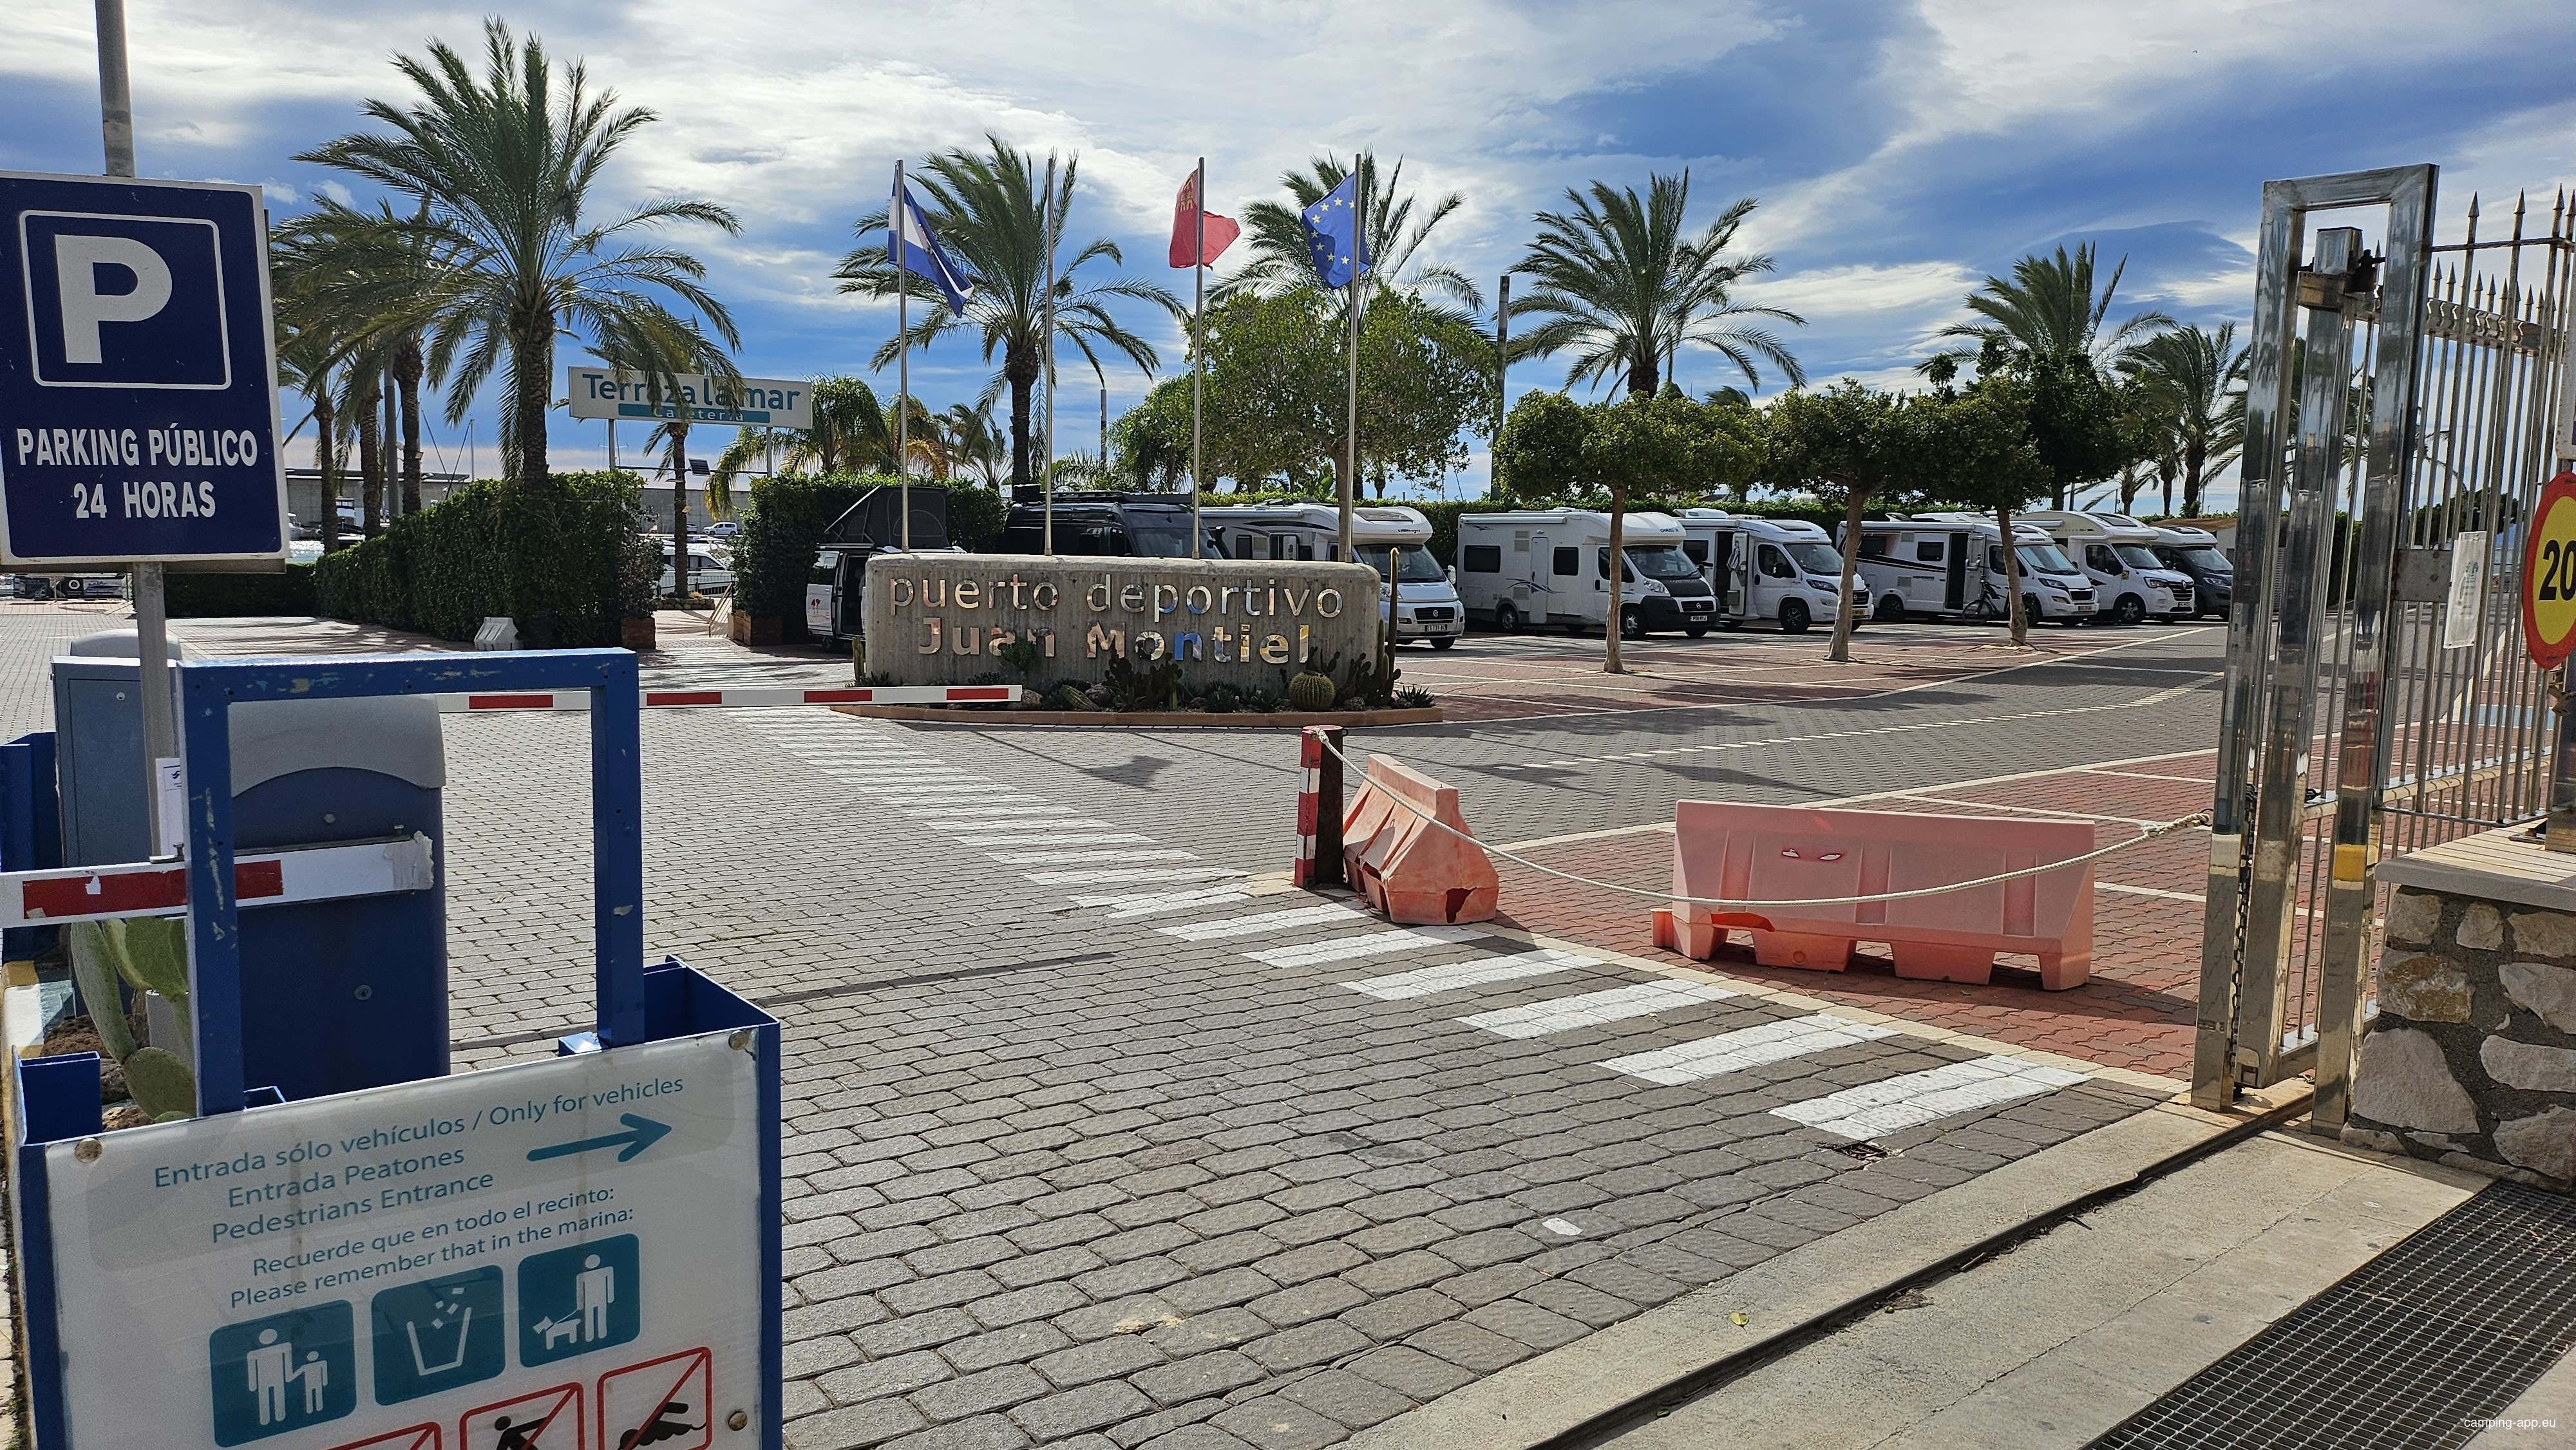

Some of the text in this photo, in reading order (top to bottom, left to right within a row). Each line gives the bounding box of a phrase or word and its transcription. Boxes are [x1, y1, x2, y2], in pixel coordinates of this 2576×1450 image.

[55, 234, 173, 364] P
[17, 422, 258, 467] PARKING PÚBLICO
[73, 481, 216, 519] 24 HORAS
[889, 573, 1344, 623] puerto deportivo
[2538, 539, 2576, 601] 20
[918, 617, 1311, 664] Juan Montiel
[155, 1078, 684, 1188] Entrada sólo vehículos / Only for vehicles
[212, 1173, 494, 1243] Pedestrians Entrance
[229, 1149, 464, 1208] Entrada Peatones
[231, 1208, 634, 1309] Please remember that in the marina:
[252, 1188, 614, 1276] Recuerde que en todo el recinto:
